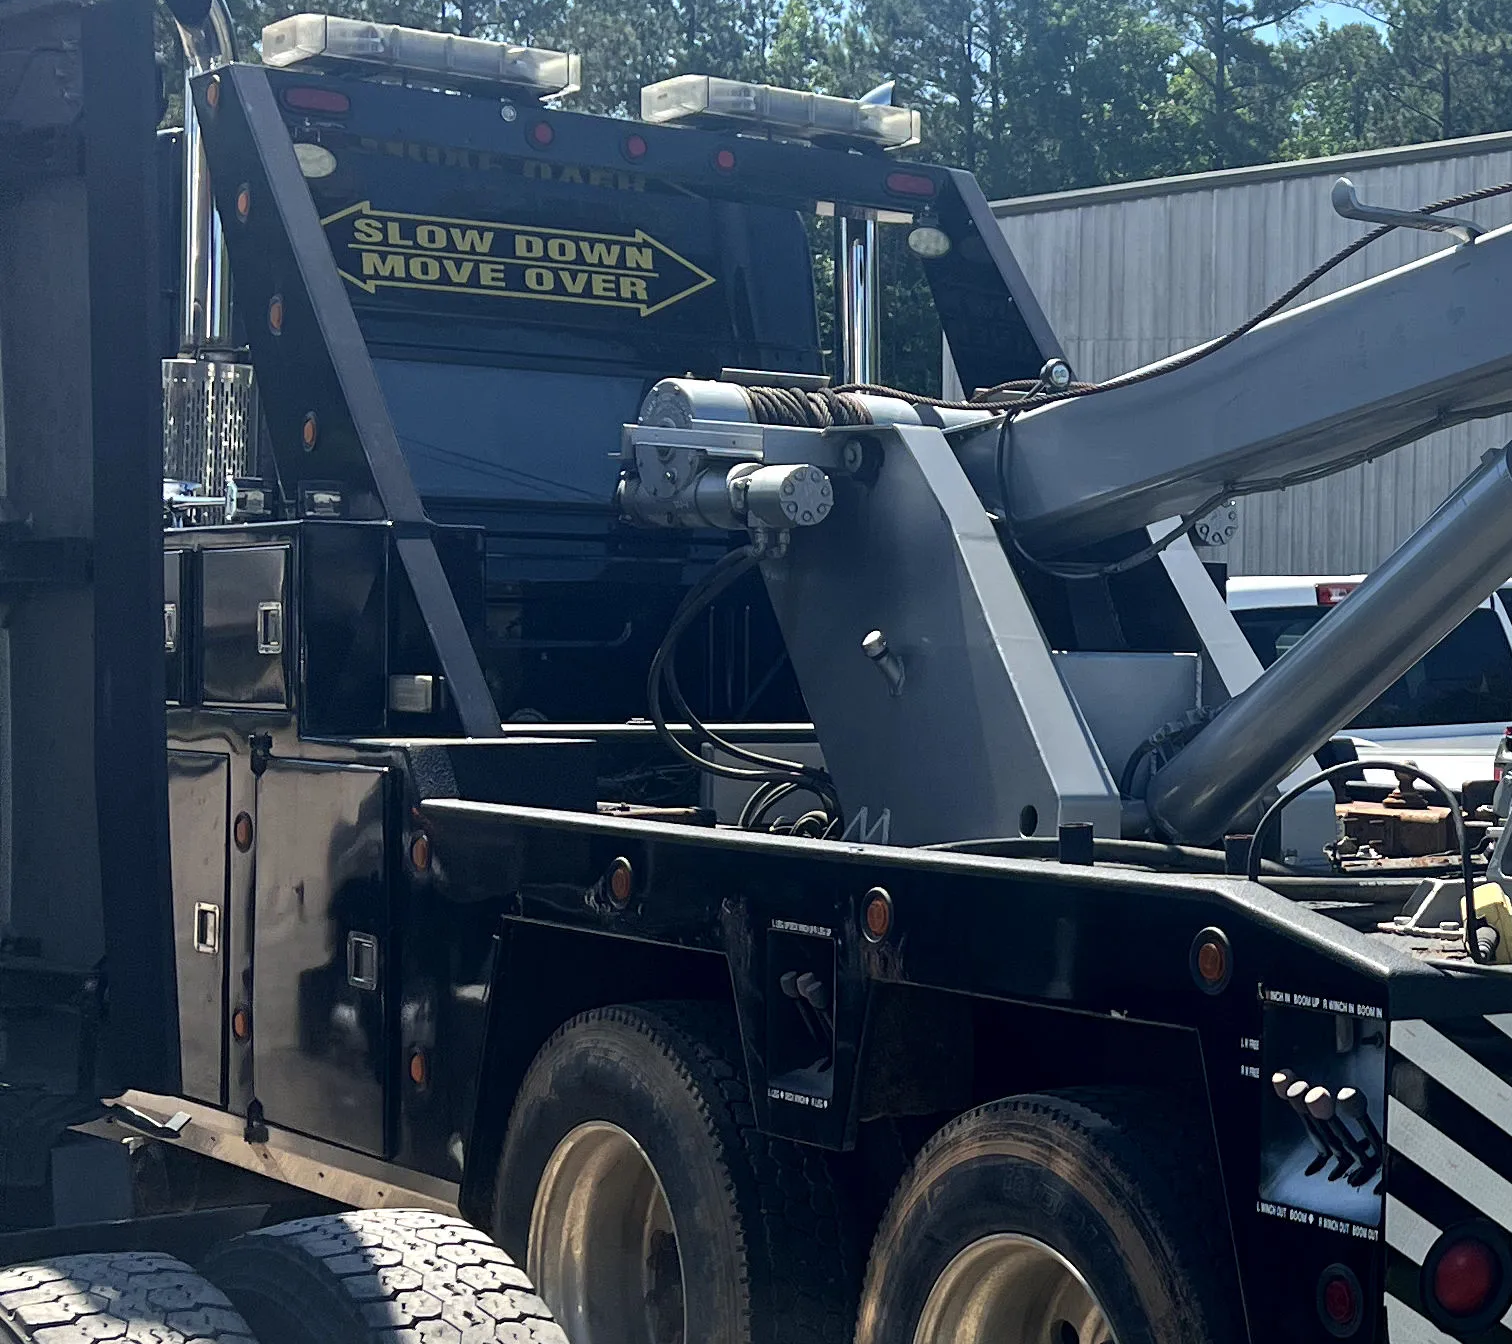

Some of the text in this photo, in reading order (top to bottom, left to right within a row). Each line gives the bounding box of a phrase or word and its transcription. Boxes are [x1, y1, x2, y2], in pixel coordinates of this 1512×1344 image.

[353, 217, 654, 270] SLOW DOWN
[361, 252, 649, 300] MOVE OVER
